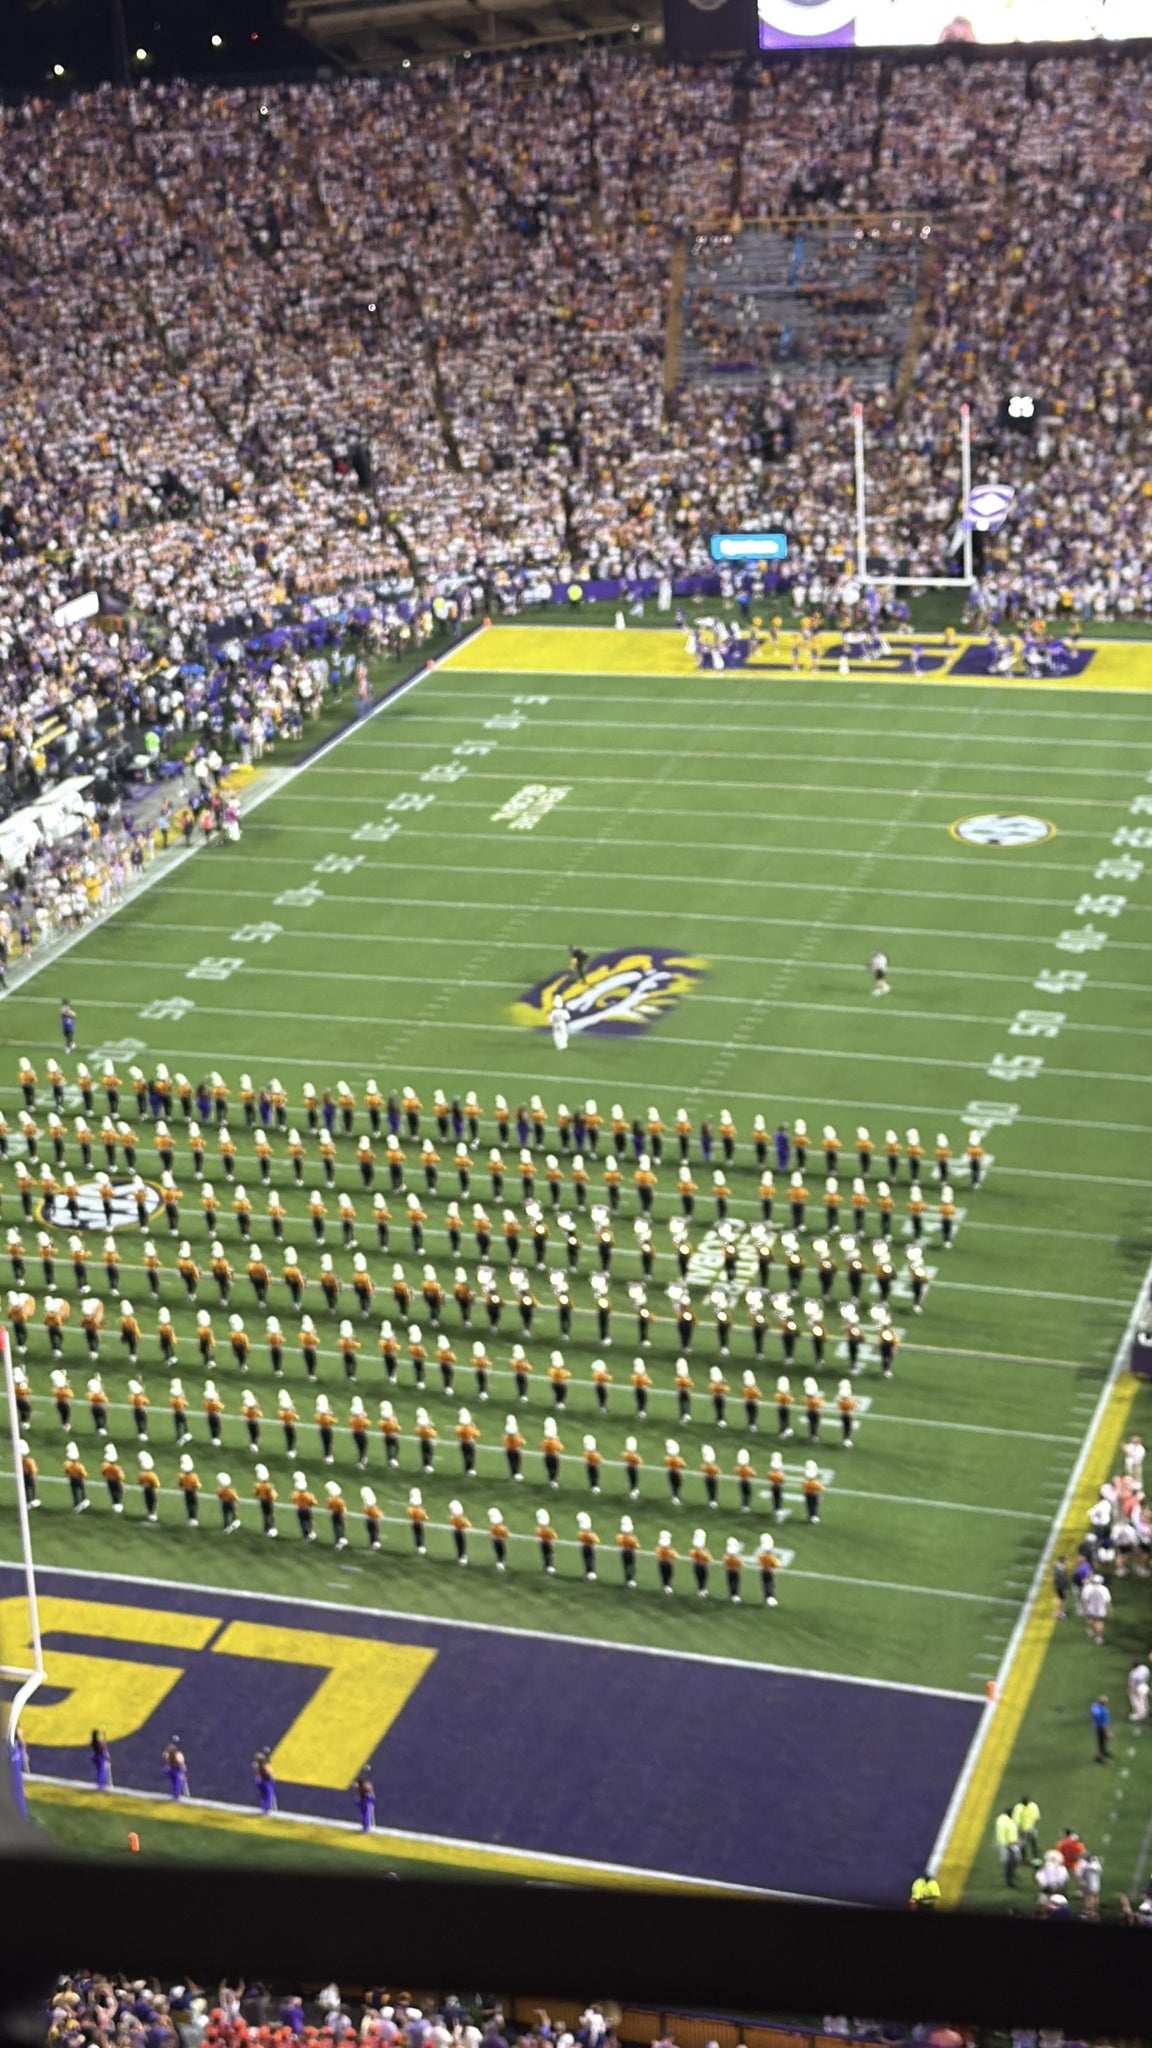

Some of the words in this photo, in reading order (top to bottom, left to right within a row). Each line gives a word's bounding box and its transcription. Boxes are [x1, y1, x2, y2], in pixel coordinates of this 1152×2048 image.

[185, 957, 245, 981] 50
[1033, 970, 1088, 994] 45
[137, 996, 195, 1021] 45
[1008, 1010, 1067, 1038] 50
[986, 1052, 1044, 1081] 45
[960, 1100, 1021, 1130] 40
